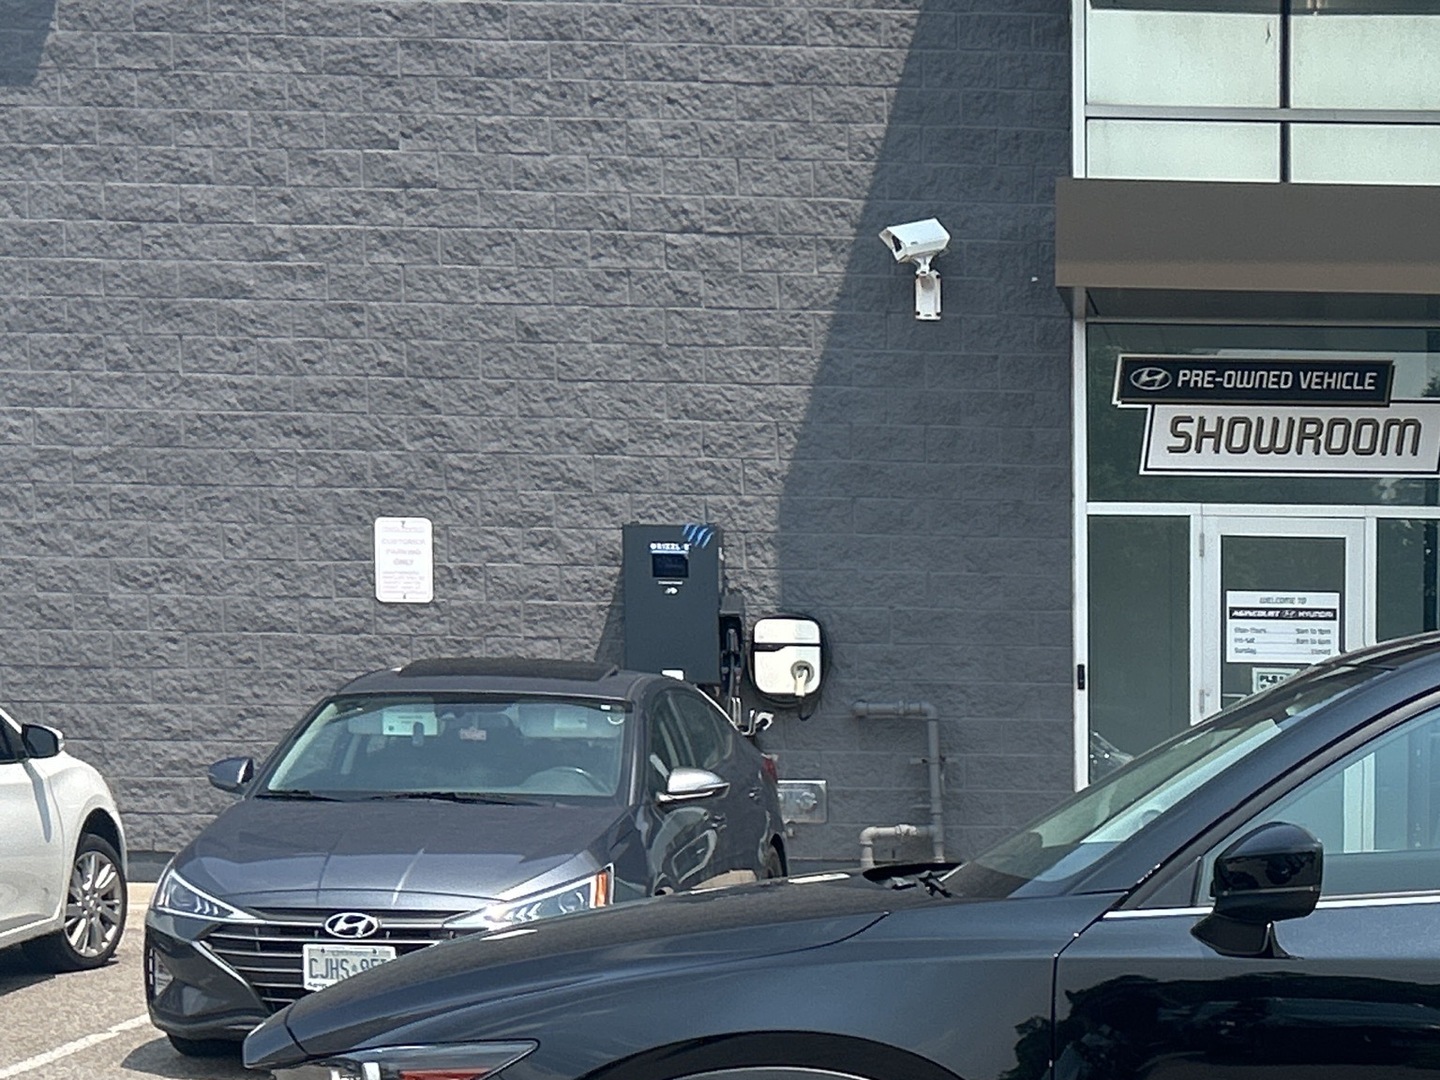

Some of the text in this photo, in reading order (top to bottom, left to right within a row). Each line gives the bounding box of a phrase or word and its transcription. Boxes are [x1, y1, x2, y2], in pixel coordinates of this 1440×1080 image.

[1177, 369, 1378, 390] PRE-OWNED VEHICLE
[1166, 415, 1422, 456] SHOWROOM
